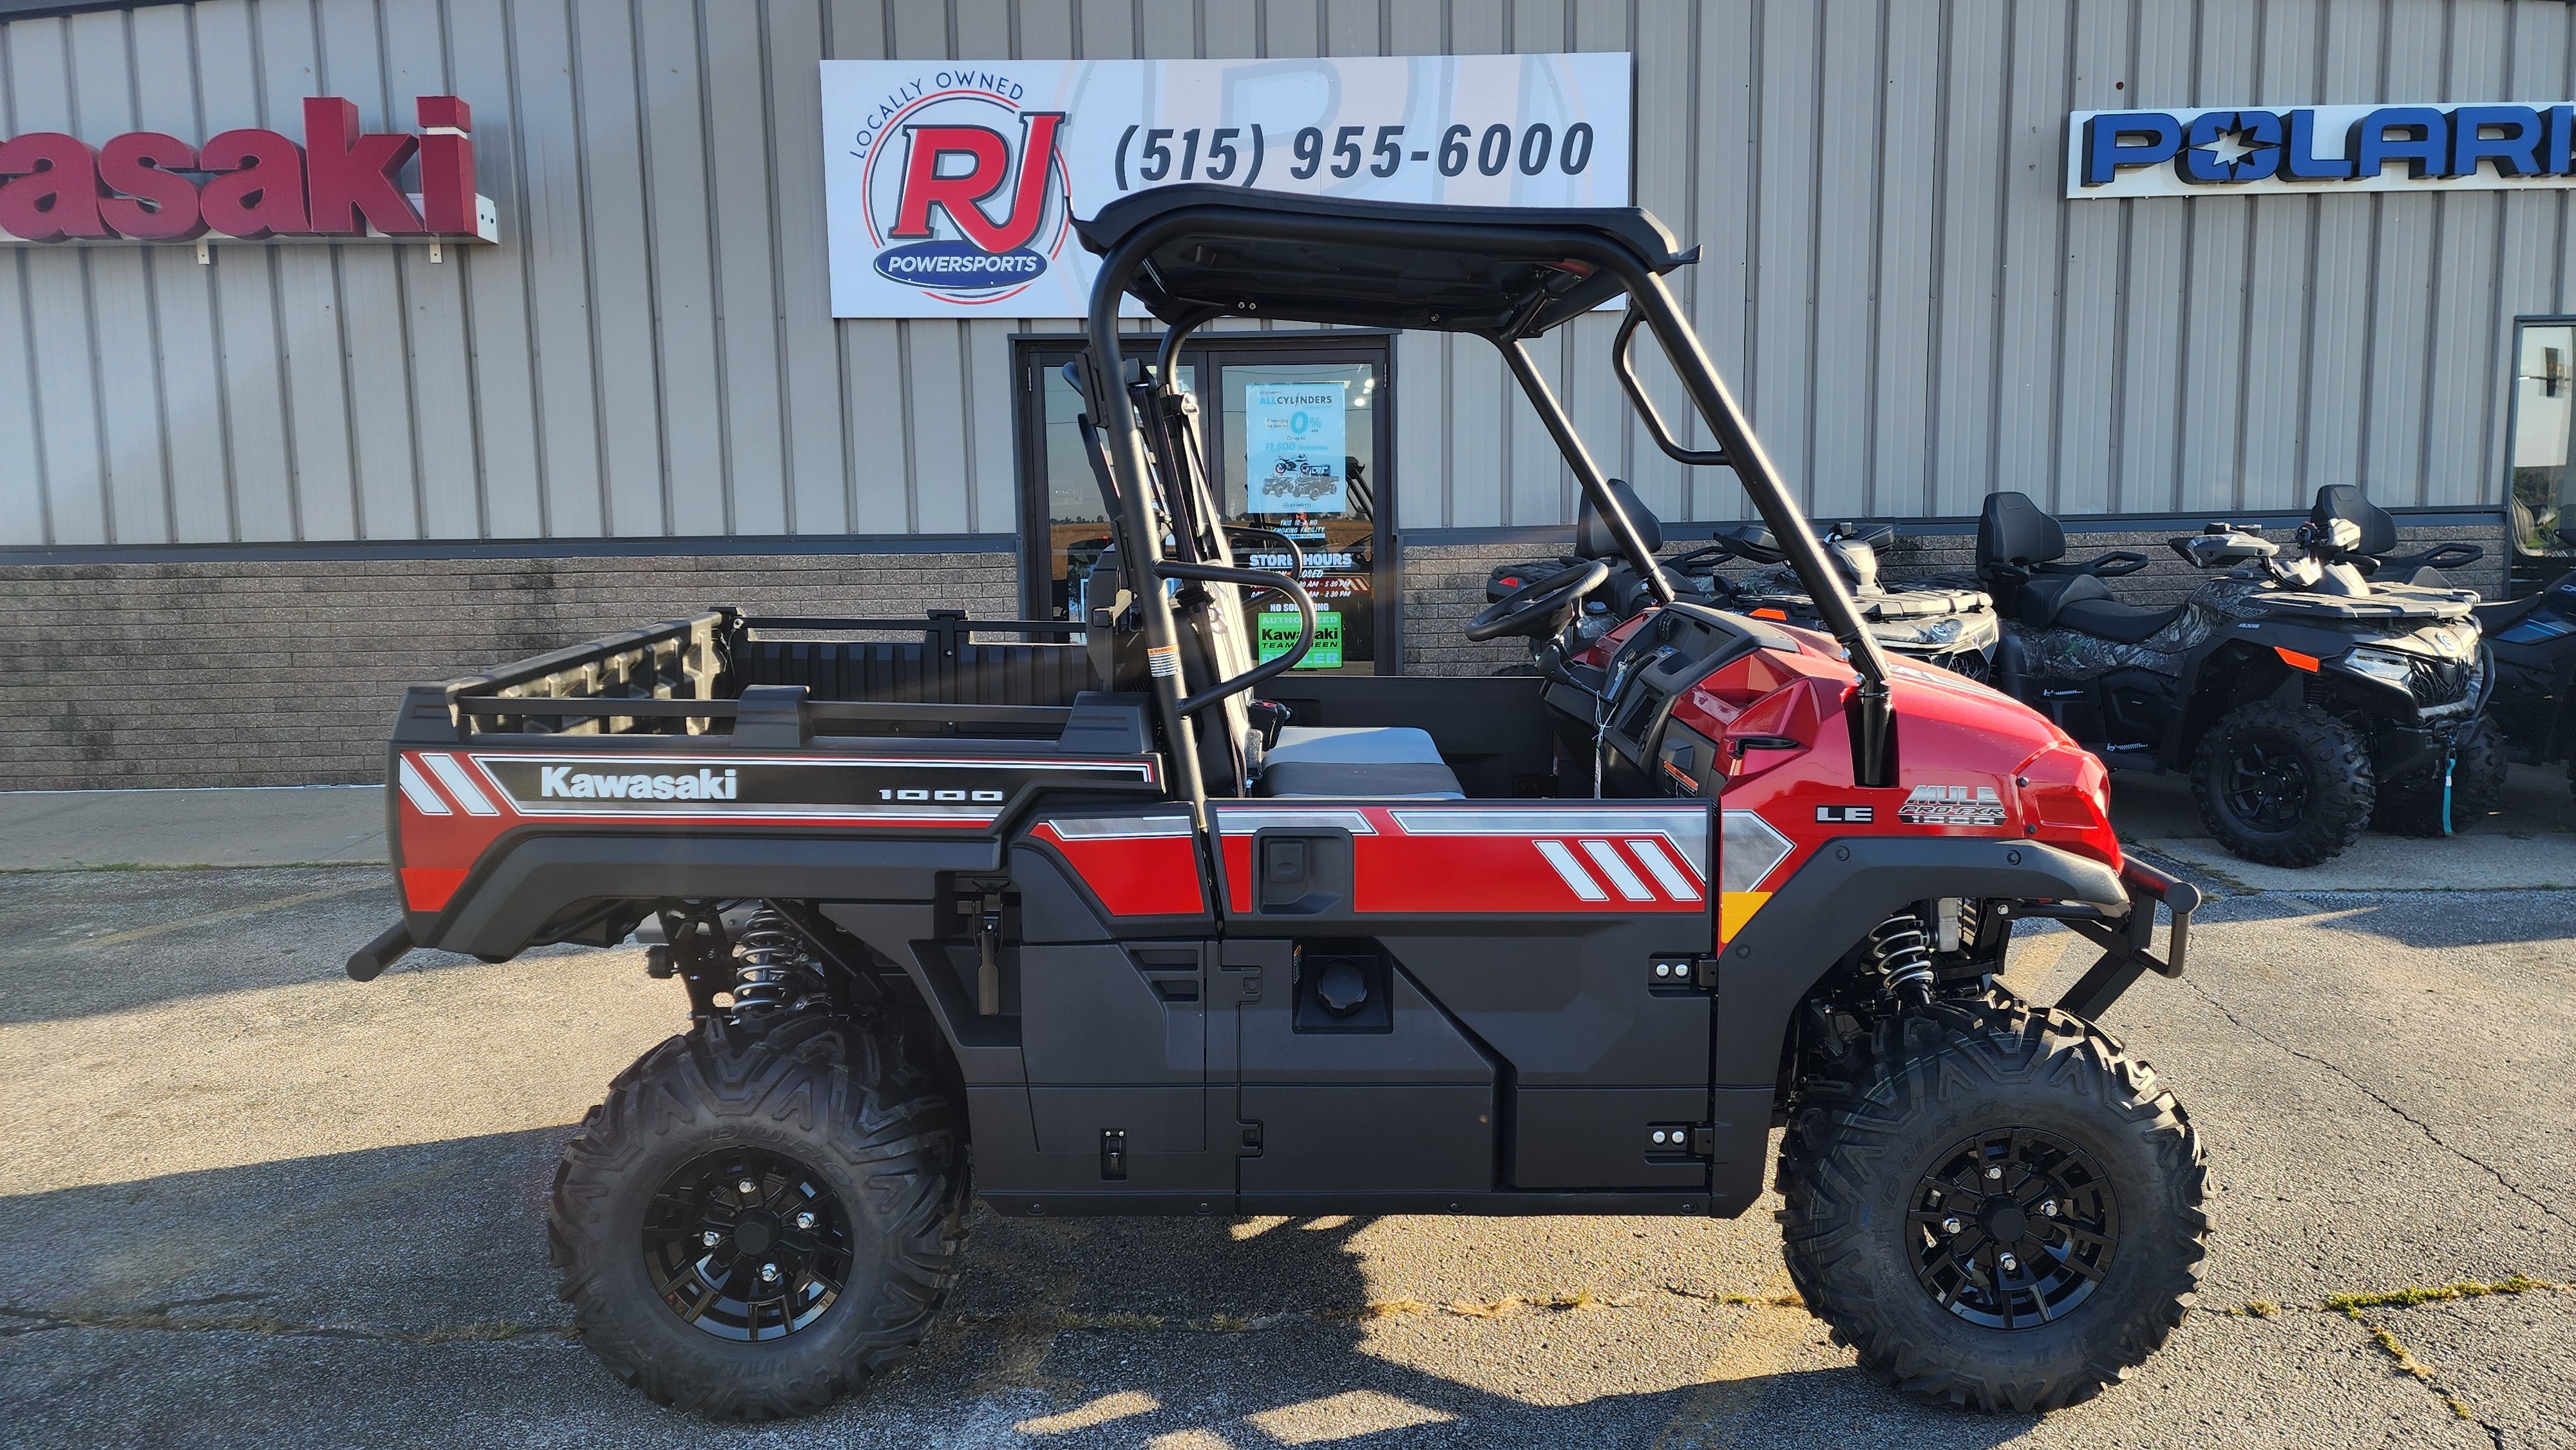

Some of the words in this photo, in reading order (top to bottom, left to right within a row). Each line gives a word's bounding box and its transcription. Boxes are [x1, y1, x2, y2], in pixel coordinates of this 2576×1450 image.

[849, 78, 924, 160] LOCALLY
[936, 70, 1023, 100] OWNED
[1114, 124, 1264, 191] (515)
[1290, 122, 1595, 180] 955-6000
[887, 111, 1066, 254] RJ
[887, 256, 1037, 272] POWERSPORTS
[1265, 442, 1296, 452] $1,500
[1249, 554, 1293, 567] STORE
[1303, 553, 1352, 565] HOURS
[1299, 569, 1323, 578] OSED
[1270, 603, 1282, 612] NO
[1262, 628, 1338, 641] Kawaki
[1262, 653, 1339, 664] DLER
[541, 766, 737, 800] Kawasaki
[878, 789, 1003, 801] 1000
[1904, 785, 2003, 806] MULE
[1817, 807, 1872, 822] LE
[1897, 805, 2005, 816] PRO-FXR
[1911, 816, 1995, 825] 1000
